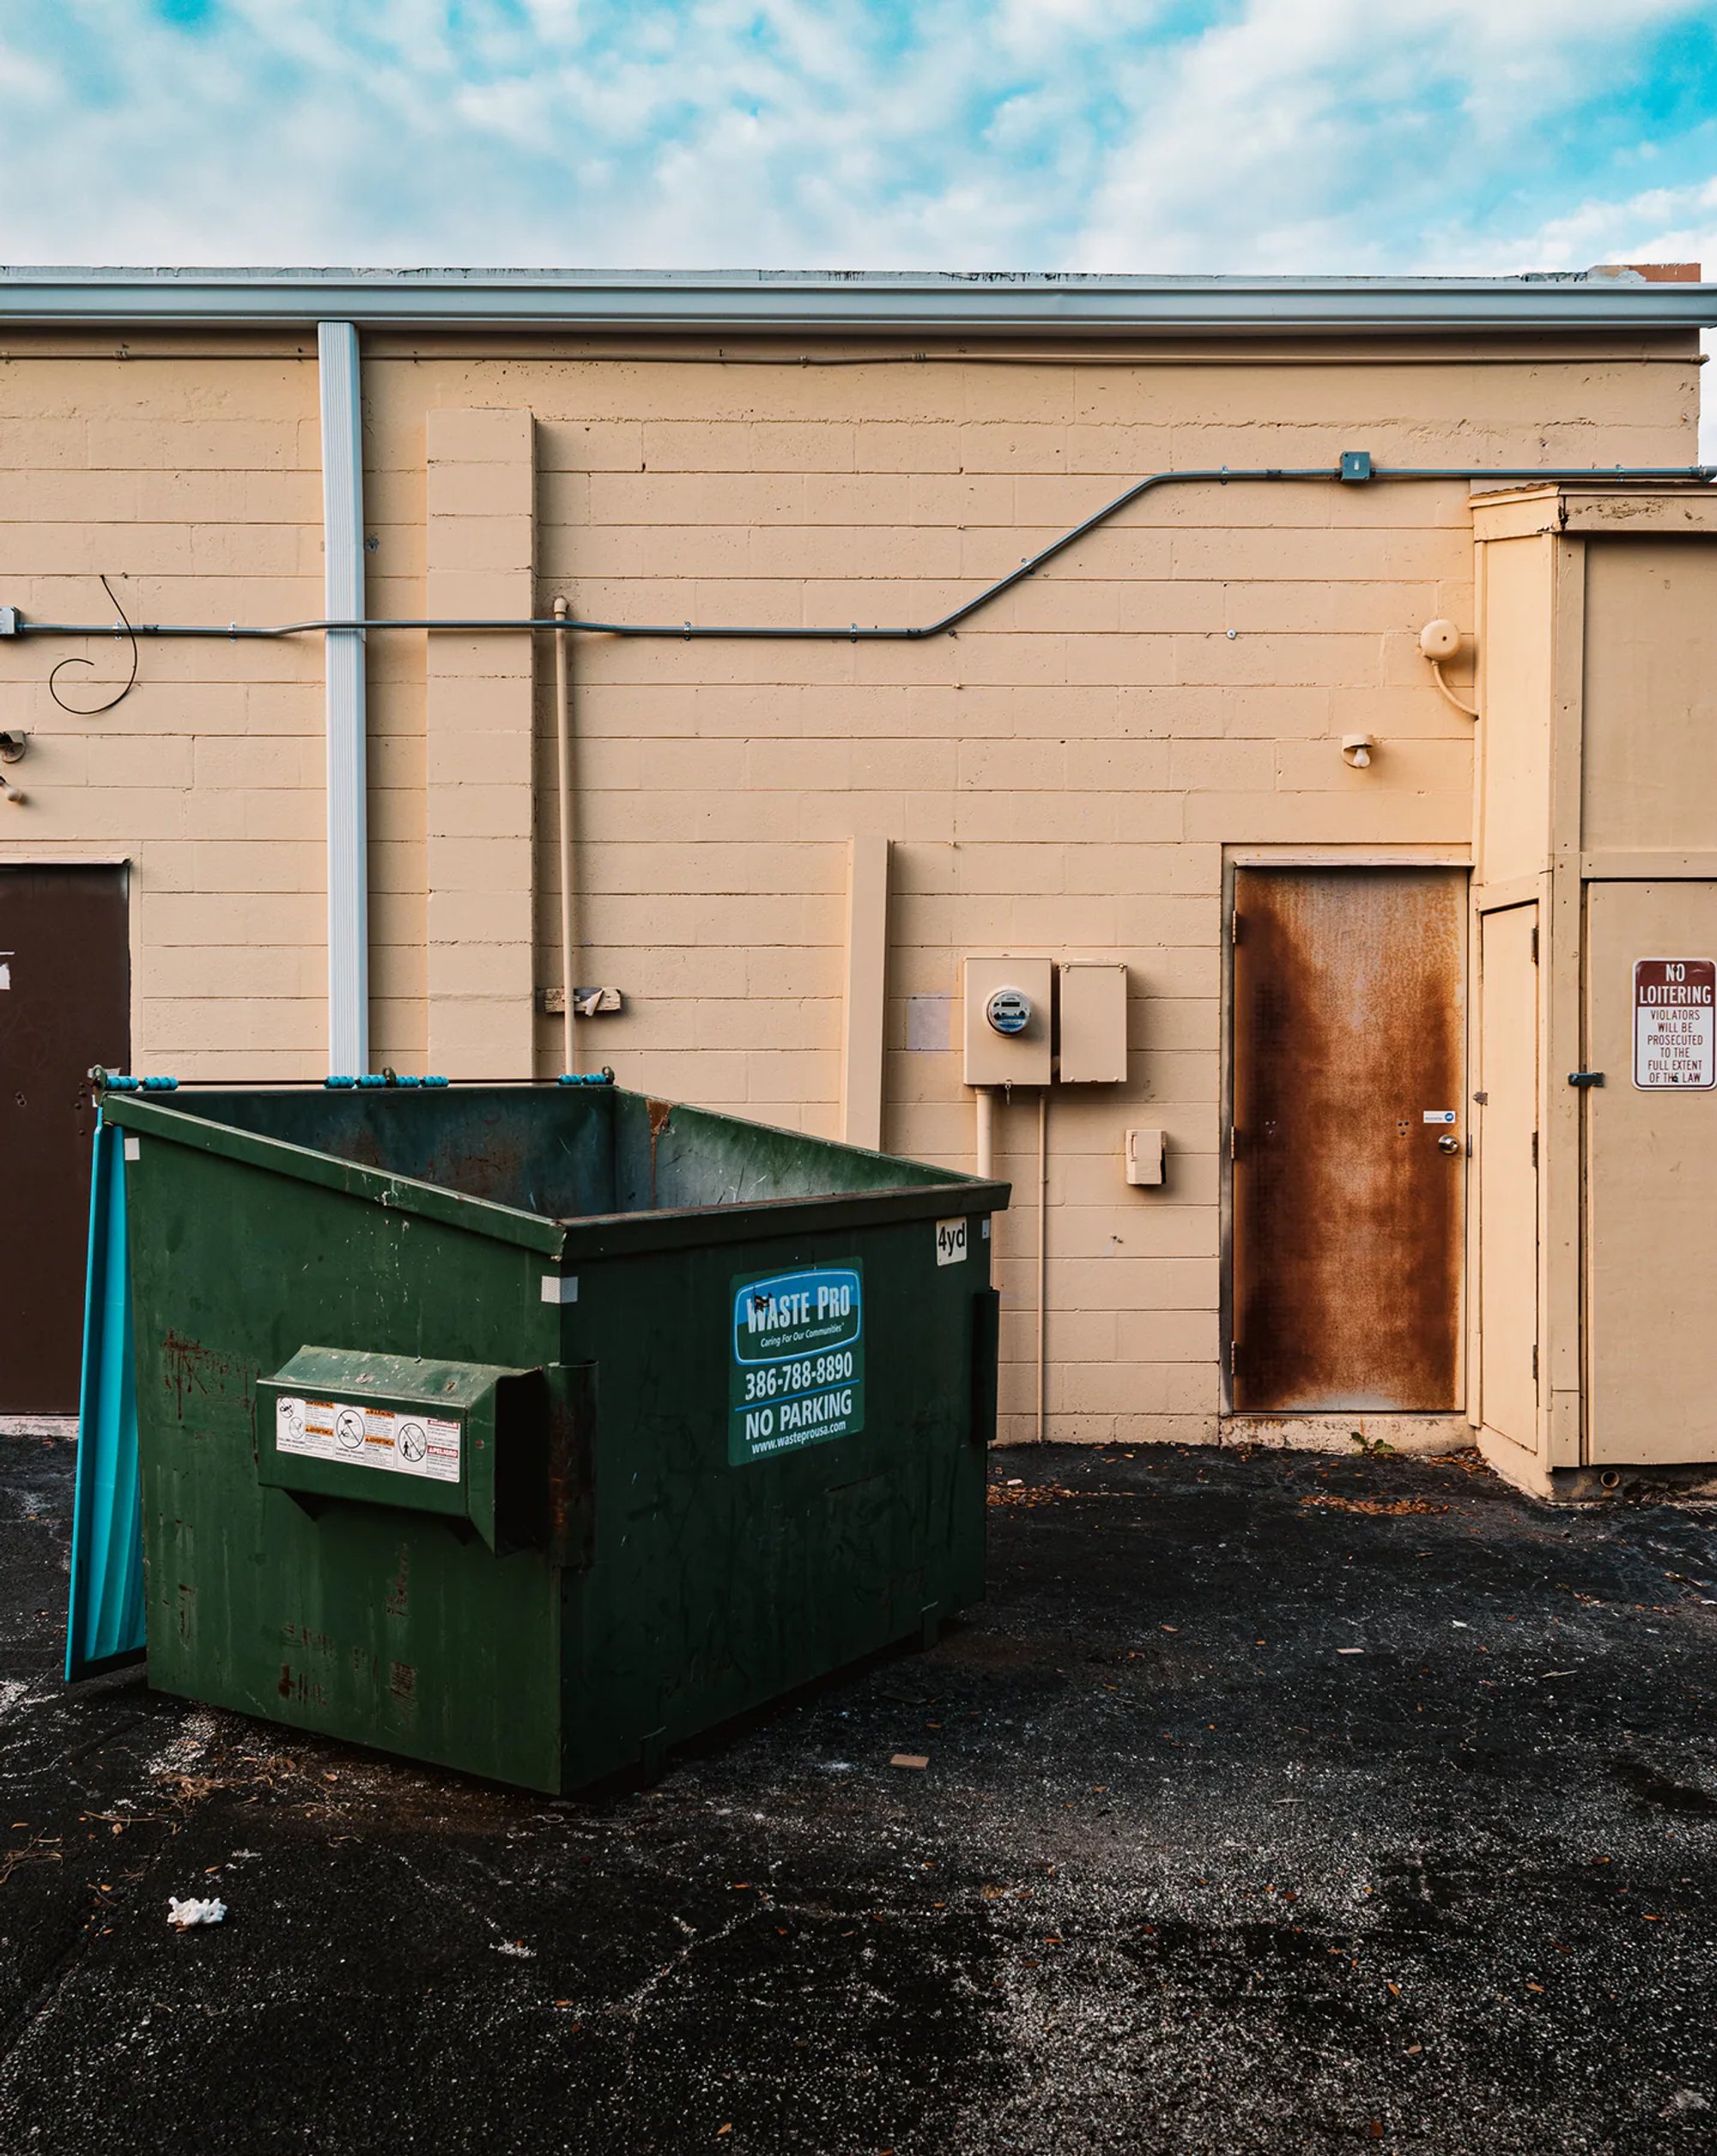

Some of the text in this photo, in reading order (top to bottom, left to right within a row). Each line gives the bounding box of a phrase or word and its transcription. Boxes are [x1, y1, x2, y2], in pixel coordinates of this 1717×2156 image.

[1665, 963, 1685, 983] NO
[1639, 985, 1711, 1004] LOITERING
[1650, 1009, 1701, 1020] VIOLATORS
[1657, 1022, 1693, 1033] WILL BE
[1647, 1034, 1703, 1045] PROSECUTED
[1659, 1047, 1690, 1058] TO THE
[1647, 1059, 1702, 1071] FULL EXTENT
[1648, 1072, 1660, 1083] OF
[1683, 1072, 1702, 1083] LAW
[938, 1222, 966, 1257] 4yd
[746, 1285, 851, 1334] WASTE PRO
[761, 1324, 843, 1348] Caring For Our Communities
[744, 1351, 853, 1401] 386-788-8890
[745, 1389, 852, 1440] NO PARKING
[751, 1419, 846, 1455] www.wasteprousa.com
